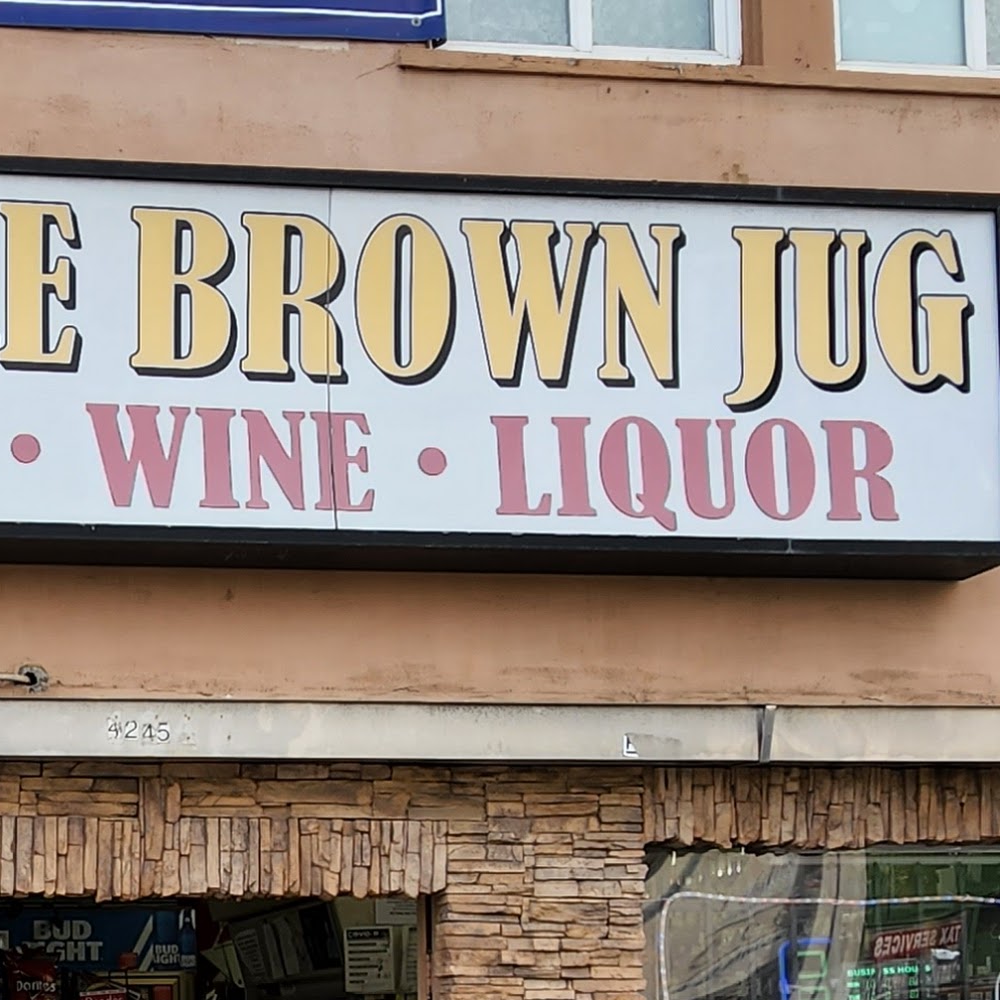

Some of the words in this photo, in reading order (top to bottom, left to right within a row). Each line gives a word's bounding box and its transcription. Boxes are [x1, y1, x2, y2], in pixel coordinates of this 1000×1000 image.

[129, 206, 686, 388] BROWN
[723, 226, 975, 413] JUG
[85, 402, 375, 512] WINE
[490, 415, 899, 532] LIQUOR
[22, 941, 103, 961] GHT
[33, 919, 92, 940] BUD
